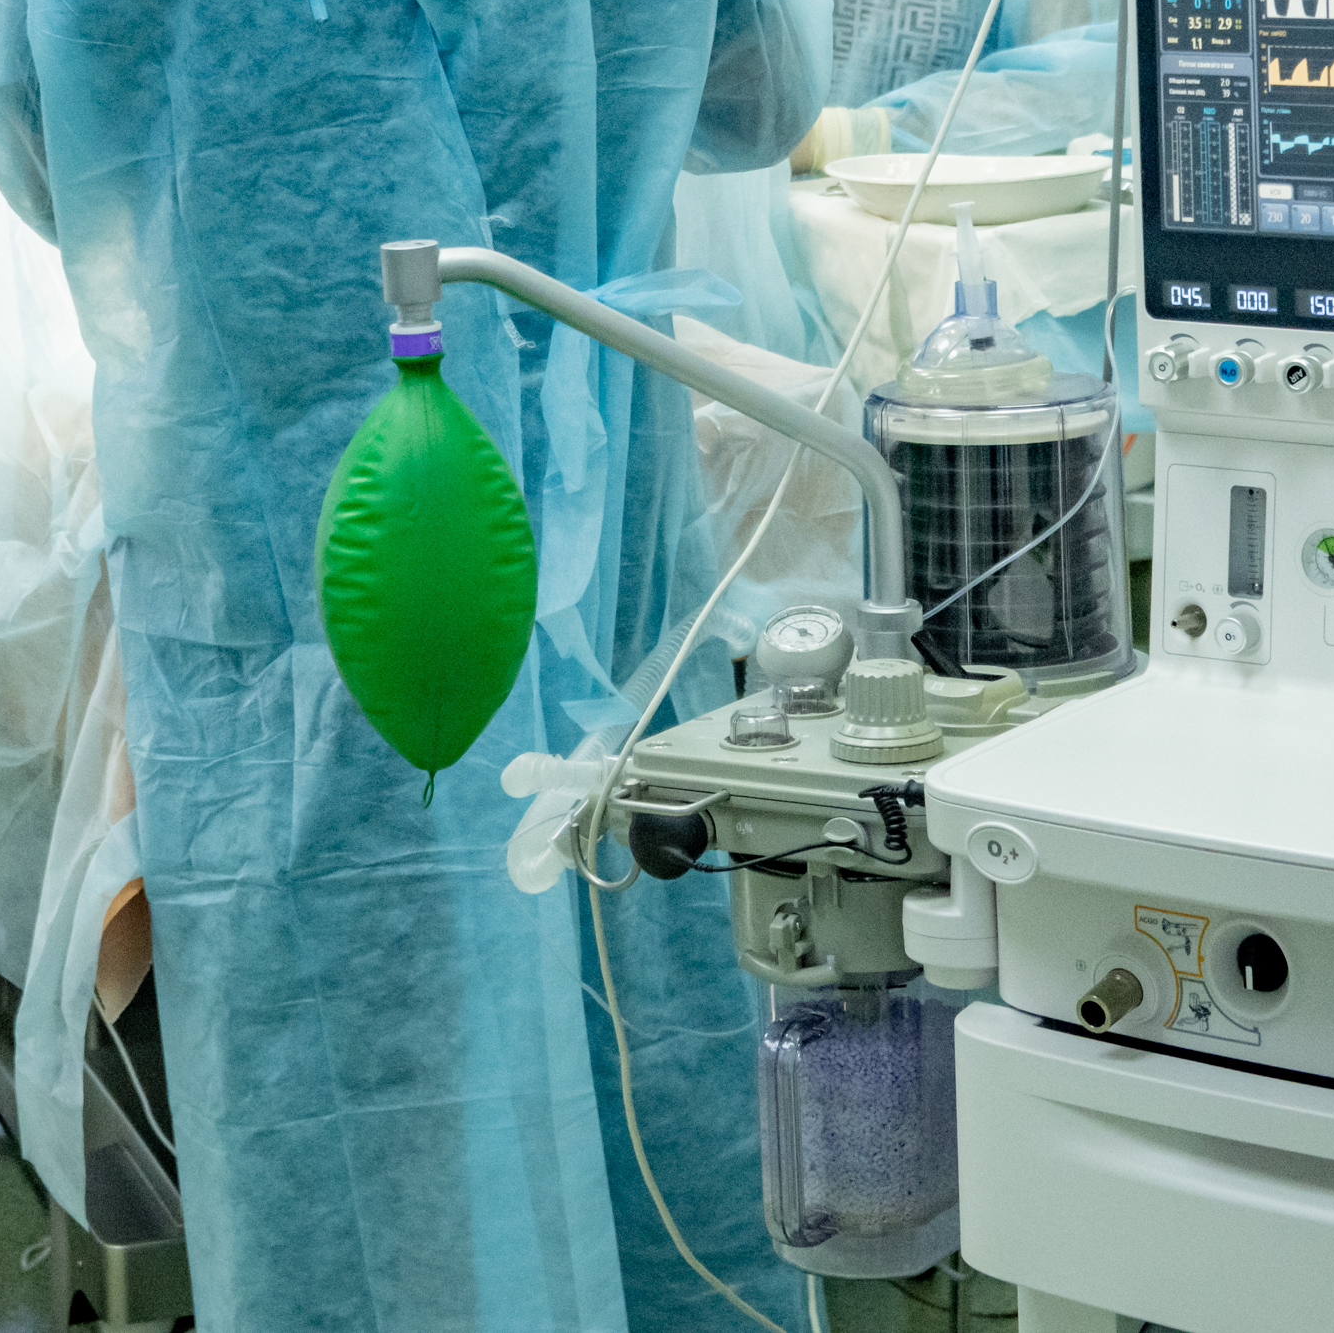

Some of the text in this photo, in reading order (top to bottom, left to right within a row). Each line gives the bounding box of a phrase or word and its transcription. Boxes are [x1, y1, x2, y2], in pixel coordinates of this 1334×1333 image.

[1188, 16, 1202, 29] 3.5
[1218, 17, 1232, 30] 2.9
[1220, 78, 1231, 87] 2.0
[1222, 89, 1231, 98] 39
[1233, 108, 1244, 116] AIR
[1267, 212, 1283, 223] 230
[1300, 213, 1311, 224] 20
[1289, 369, 1305, 384] AIR
[1138, 916, 1159, 925] ACGO
